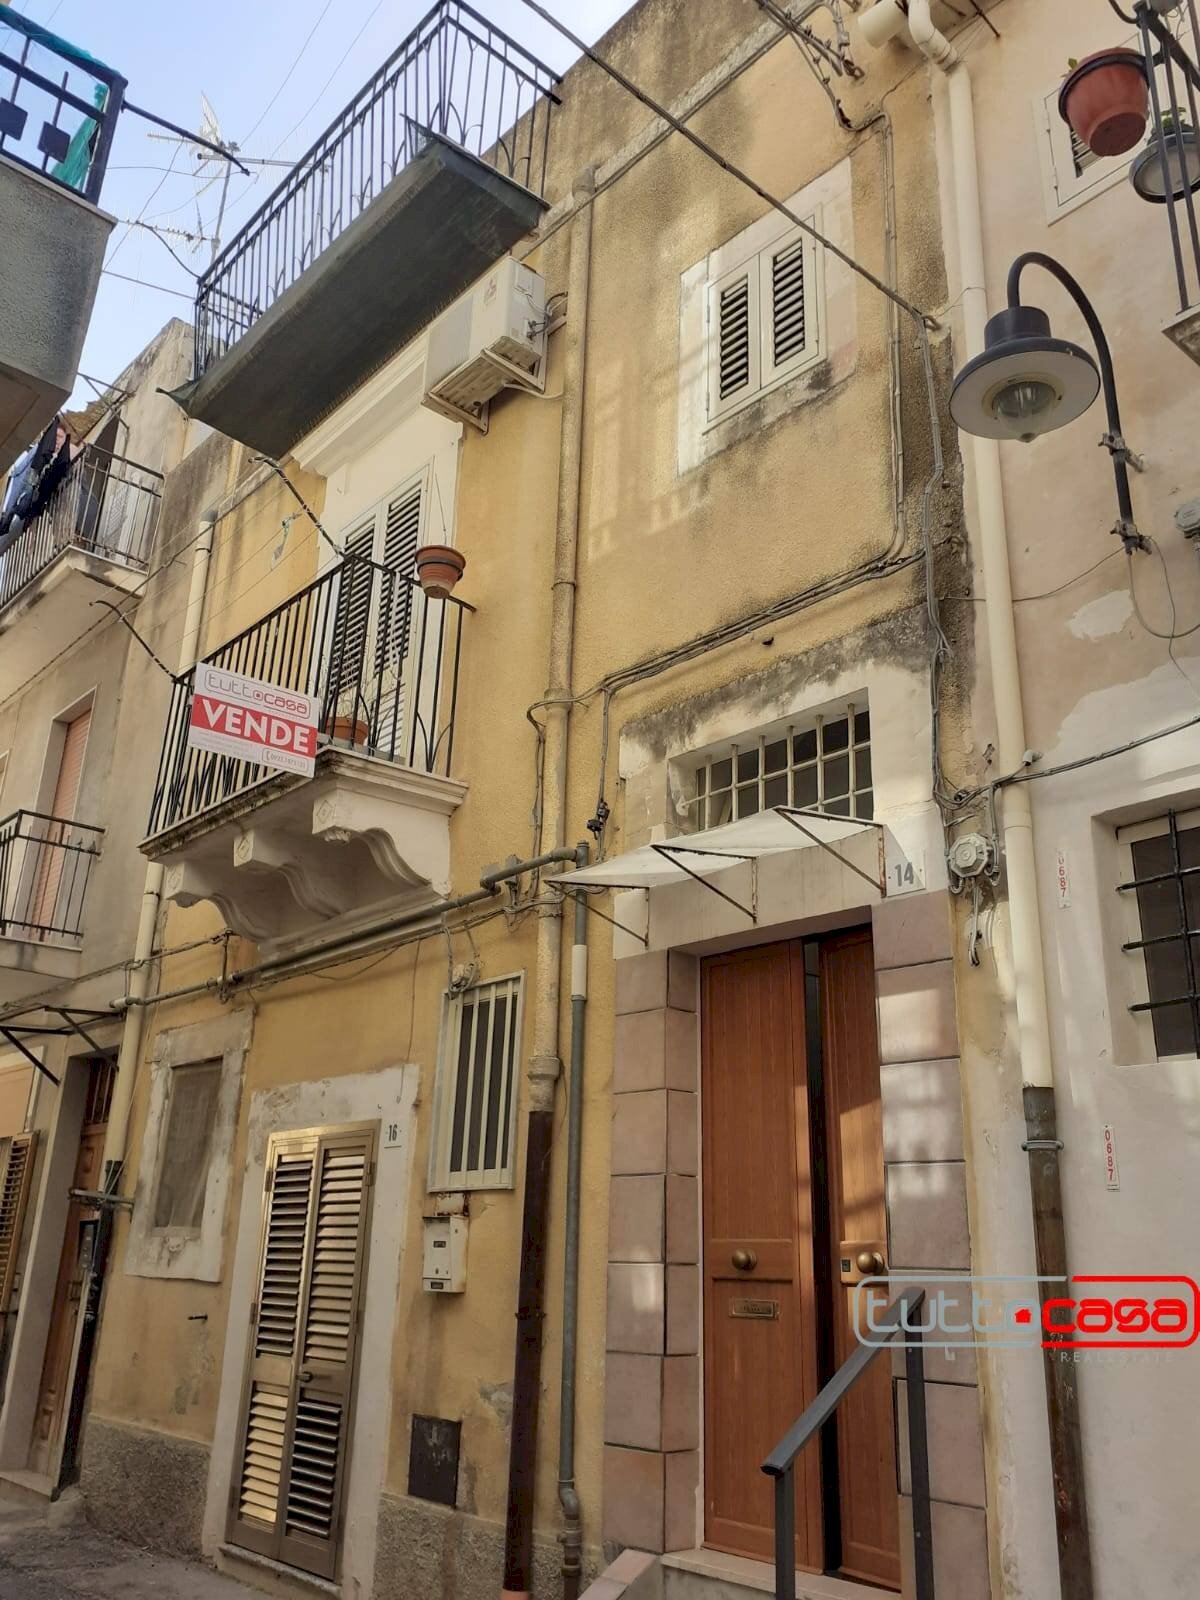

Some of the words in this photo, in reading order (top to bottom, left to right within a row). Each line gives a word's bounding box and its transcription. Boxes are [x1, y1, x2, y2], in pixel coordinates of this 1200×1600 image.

[202, 698, 310, 753] VENDE
[895, 861, 914, 887] 14
[389, 1124, 398, 1141] 16
[1104, 1130, 1114, 1181] 0687
